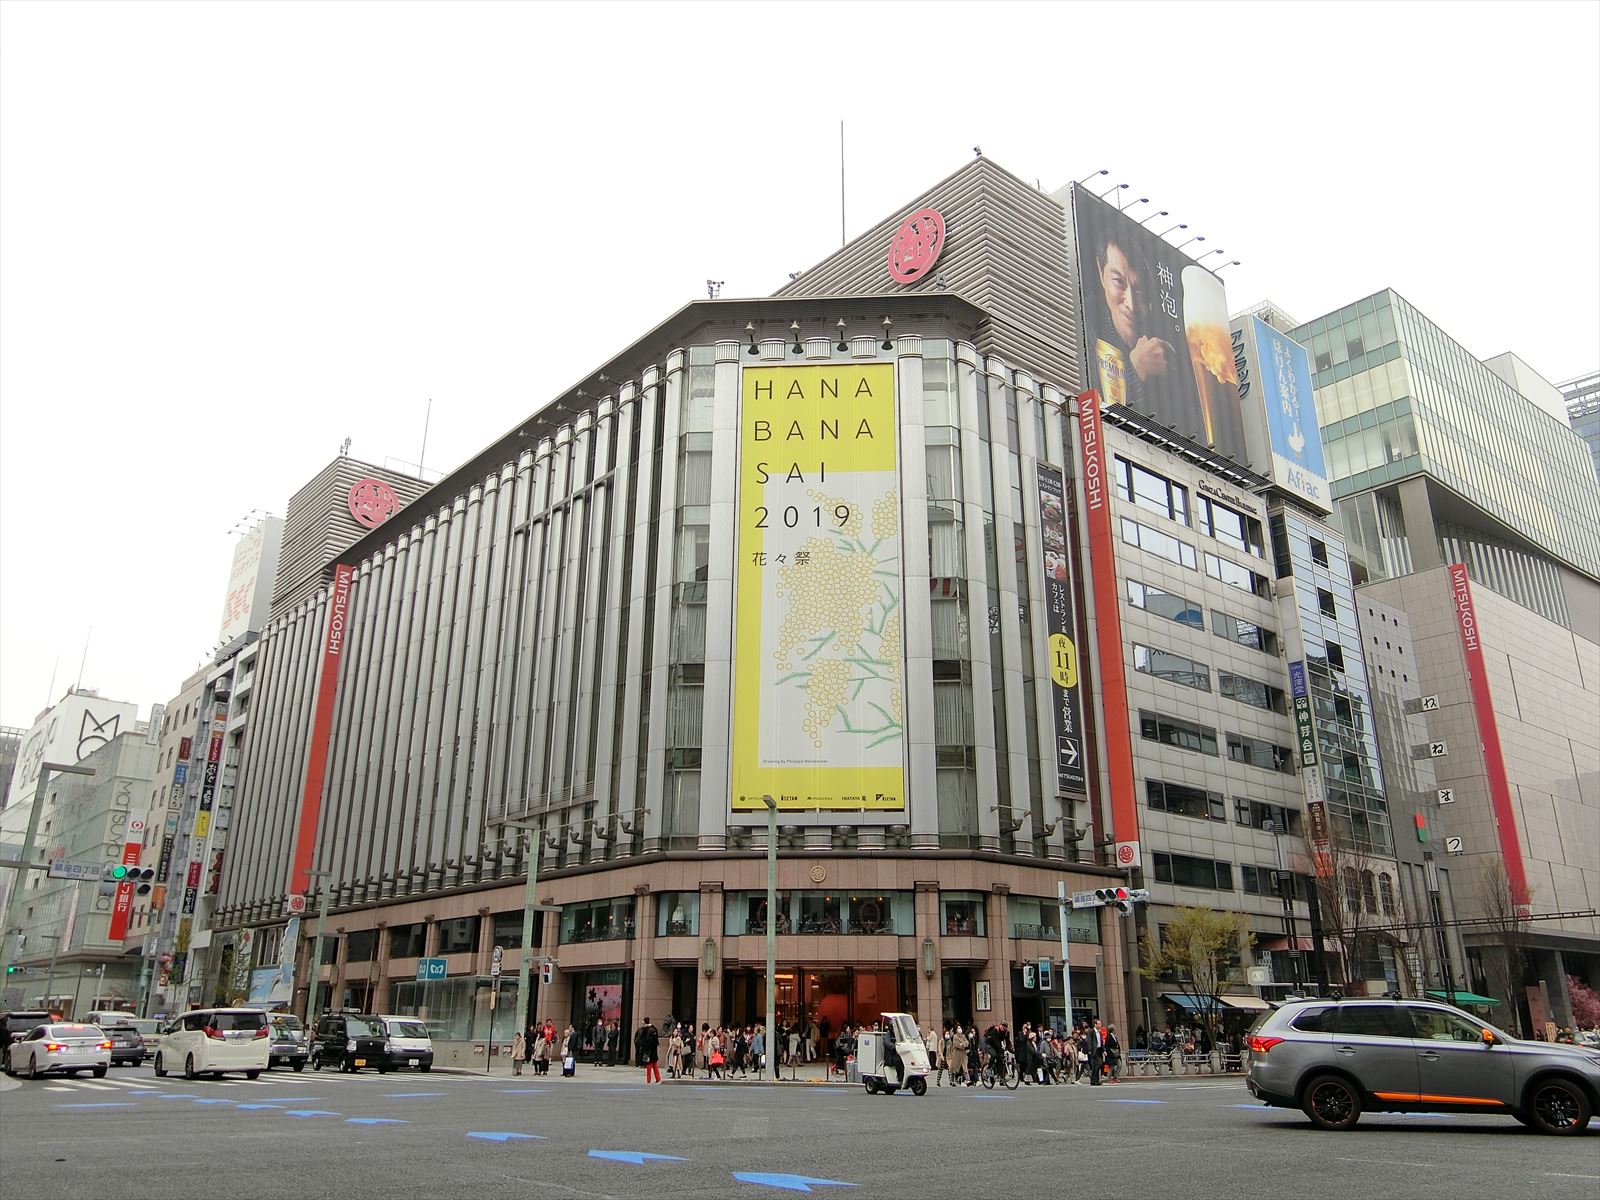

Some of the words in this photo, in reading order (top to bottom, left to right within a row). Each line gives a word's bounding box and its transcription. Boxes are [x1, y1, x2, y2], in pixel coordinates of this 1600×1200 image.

[1156, 261, 1181, 332] 神泡。
[1231, 329, 1251, 398] アフラック
[1273, 338, 1293, 417] ほけん案内
[755, 377, 872, 400] HANA
[754, 418, 873, 441] BANA
[1081, 398, 1102, 510] MITSUKOSHI
[756, 462, 825, 484] SAI
[1287, 468, 1320, 500] Aflac
[755, 505, 850, 528] 2019
[752, 551, 810, 566] 花々祭
[329, 570, 350, 655] MITSUKOSHI
[1052, 582, 1060, 613] カフェは
[1453, 569, 1478, 651] MITSUKOSHI
[1062, 688, 1073, 733] まで営業
[1058, 772, 1084, 782] MITSUKOSHI
[55, 863, 100, 875] 銀座四丁目
